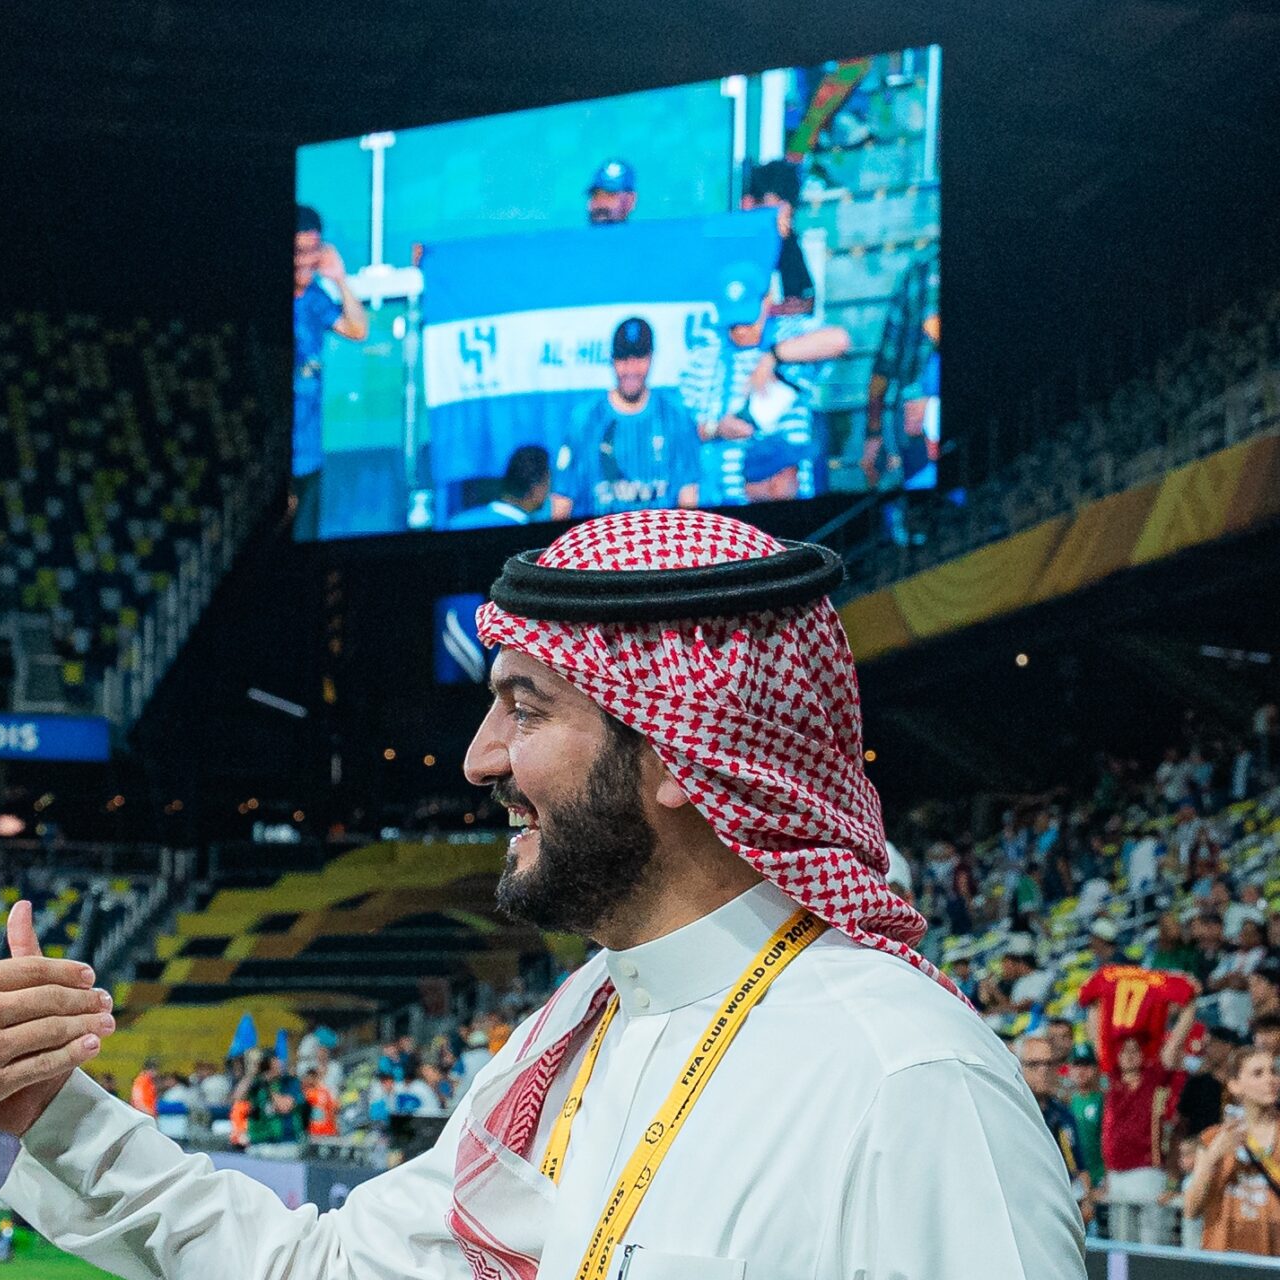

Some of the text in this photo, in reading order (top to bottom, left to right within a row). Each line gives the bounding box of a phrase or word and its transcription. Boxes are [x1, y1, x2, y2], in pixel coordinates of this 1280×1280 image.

[680, 916, 815, 1086] FIFA CLUB WORLD CUP 2025
[589, 1227, 603, 1258] CUP
